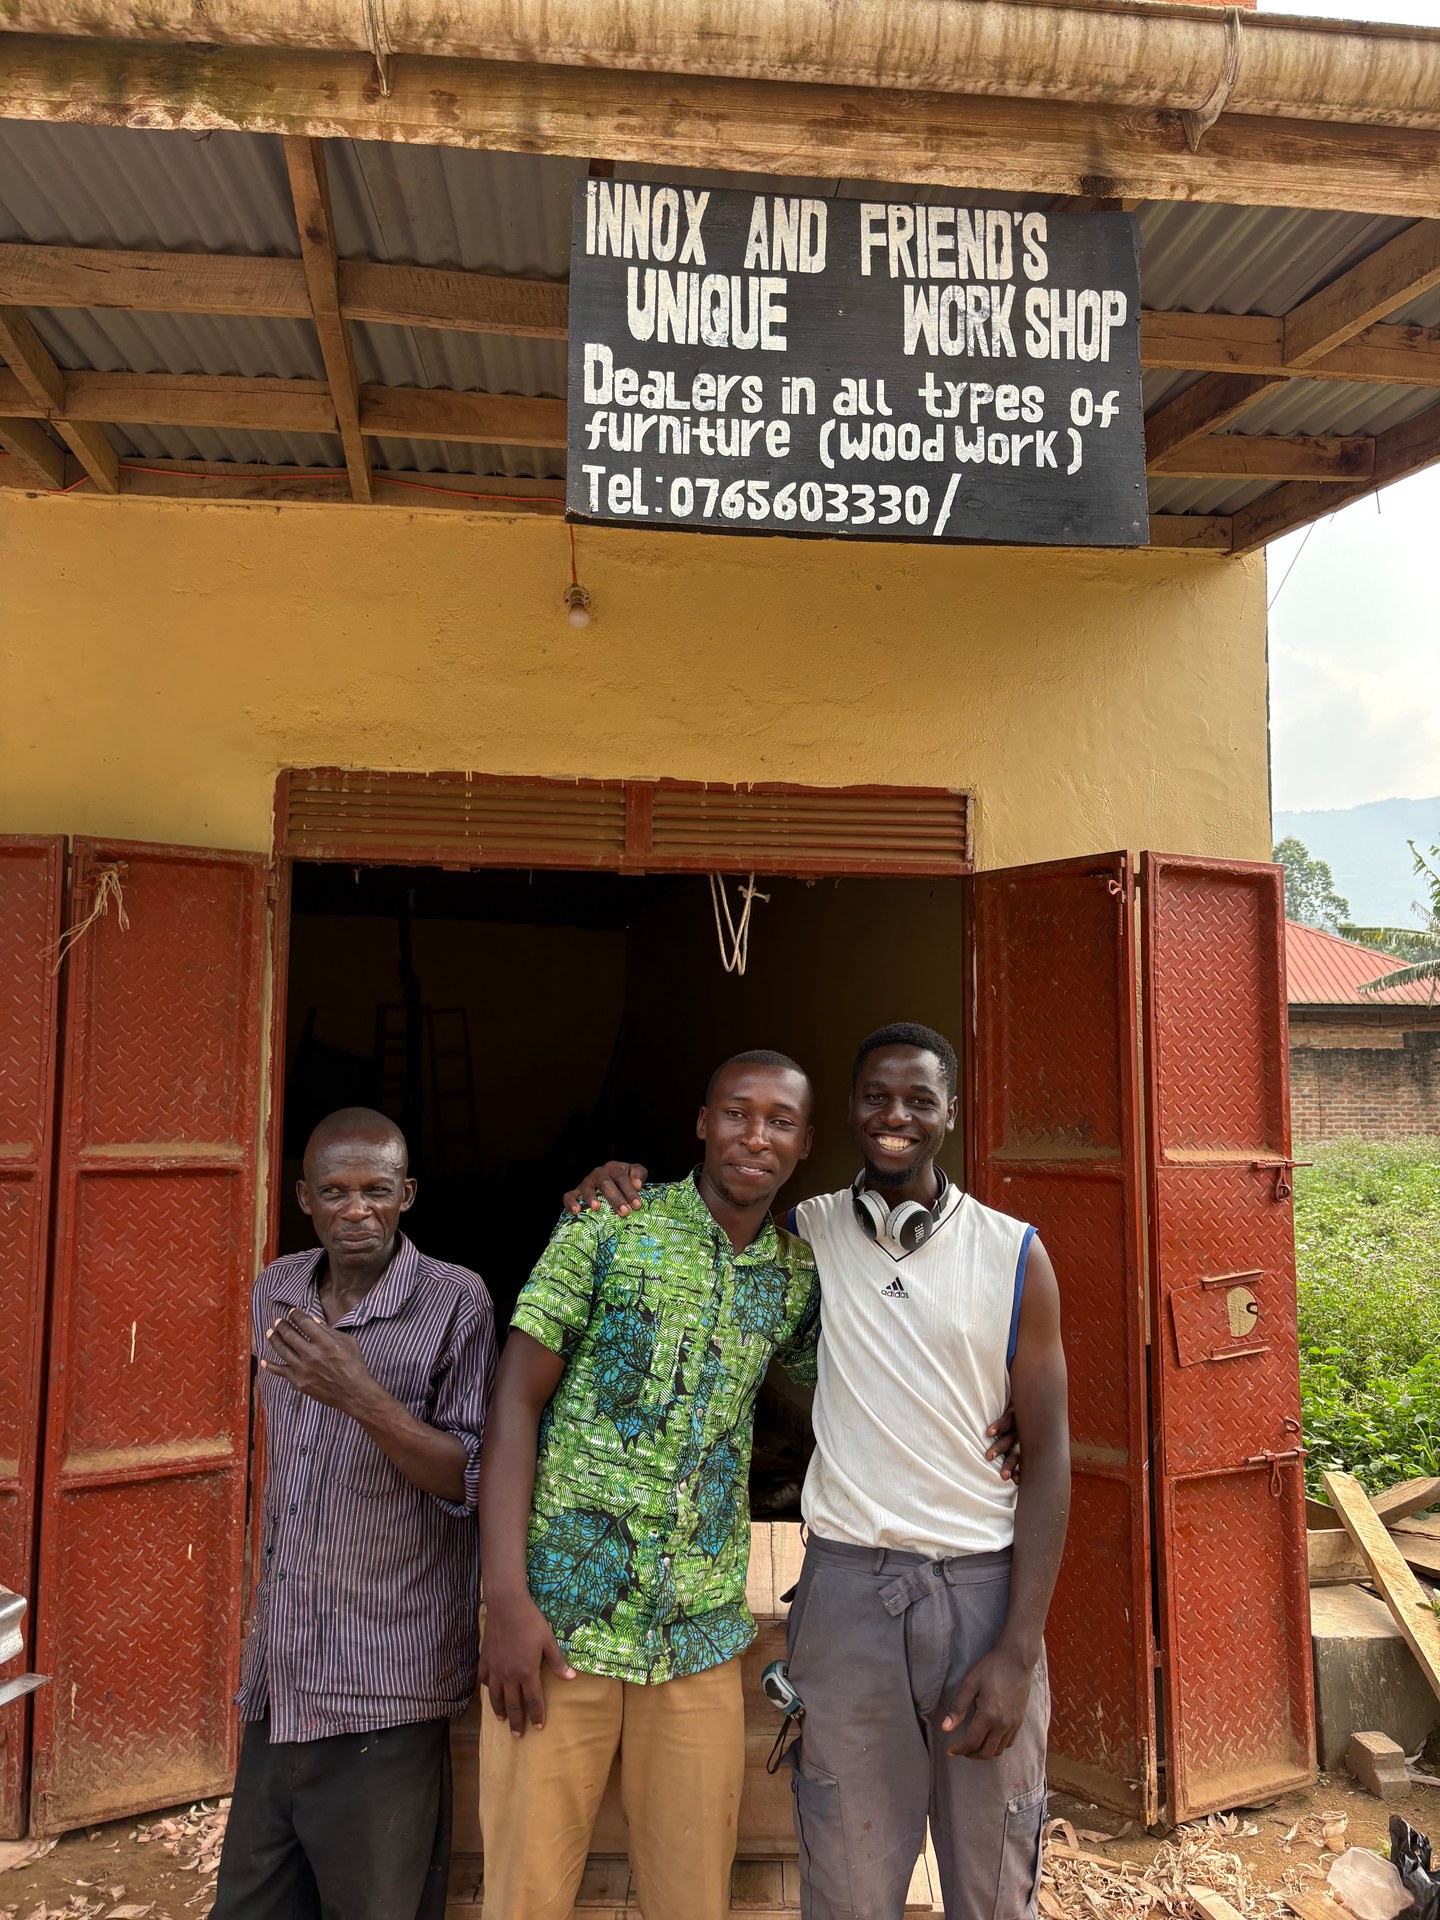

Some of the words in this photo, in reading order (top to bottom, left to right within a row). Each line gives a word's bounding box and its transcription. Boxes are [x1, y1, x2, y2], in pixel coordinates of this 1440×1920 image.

[586, 180, 711, 265] INNOX
[743, 196, 828, 274] AND
[860, 203, 1049, 281] FRIEND'S
[627, 266, 788, 351] UNIQUE
[781, 376, 816, 415] in
[832, 378, 893, 416] all
[918, 372, 1045, 424] types
[584, 410, 791, 458] furniture
[914, 1223, 925, 1243] JBL
[881, 1290, 910, 1299] adidas
